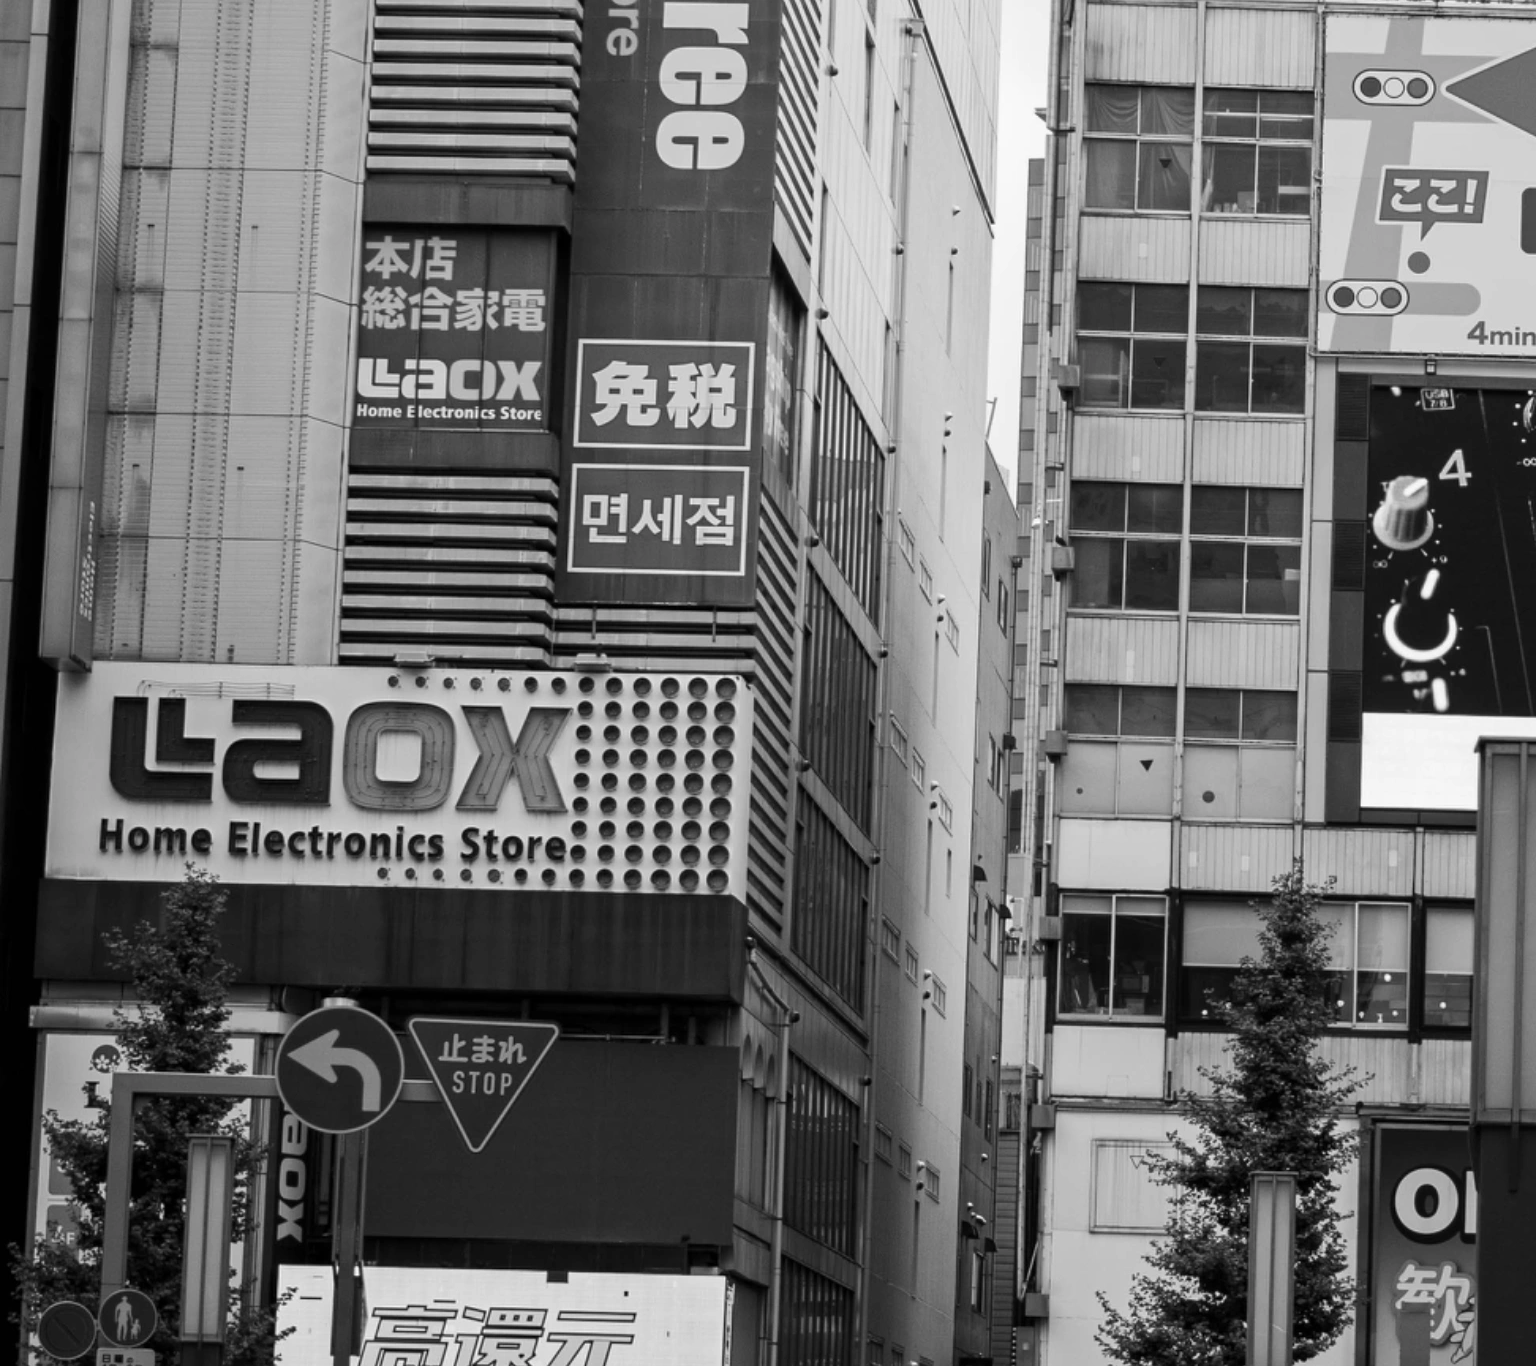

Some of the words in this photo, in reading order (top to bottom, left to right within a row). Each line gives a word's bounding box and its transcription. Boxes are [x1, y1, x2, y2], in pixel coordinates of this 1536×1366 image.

[364, 235, 458, 281] 本店
[361, 285, 547, 332] 総合家電
[356, 403, 402, 419] Home
[406, 403, 496, 421] Electronics
[500, 405, 543, 422] Store
[590, 359, 738, 430] 免税
[1438, 448, 1473, 487] 4
[581, 493, 736, 547] 면세점
[99, 817, 212, 857] Home
[227, 821, 445, 861] Electronics
[460, 826, 568, 864] Store
[437, 1035, 529, 1067] 止まれ
[451, 1071, 514, 1097] STOP
